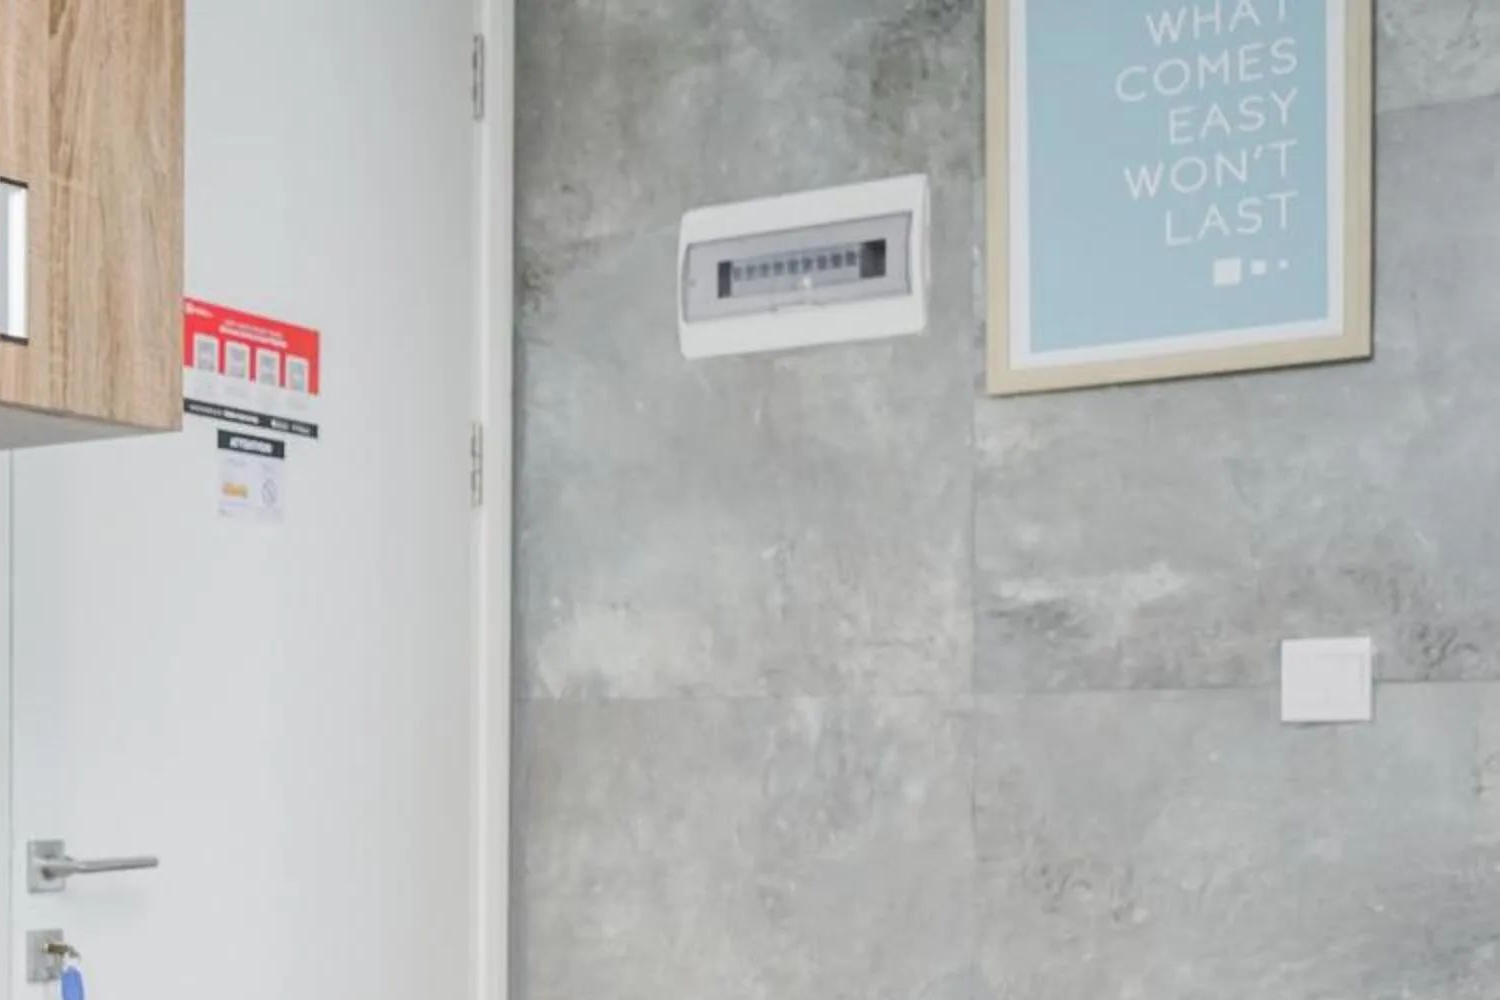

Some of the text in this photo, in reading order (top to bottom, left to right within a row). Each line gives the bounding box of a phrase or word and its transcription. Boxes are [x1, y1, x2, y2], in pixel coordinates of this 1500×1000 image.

[1115, 38, 1298, 102] COMES
[1169, 88, 1298, 145] EASY
[1124, 139, 1298, 200] WON'T
[1165, 191, 1298, 246] LAST
